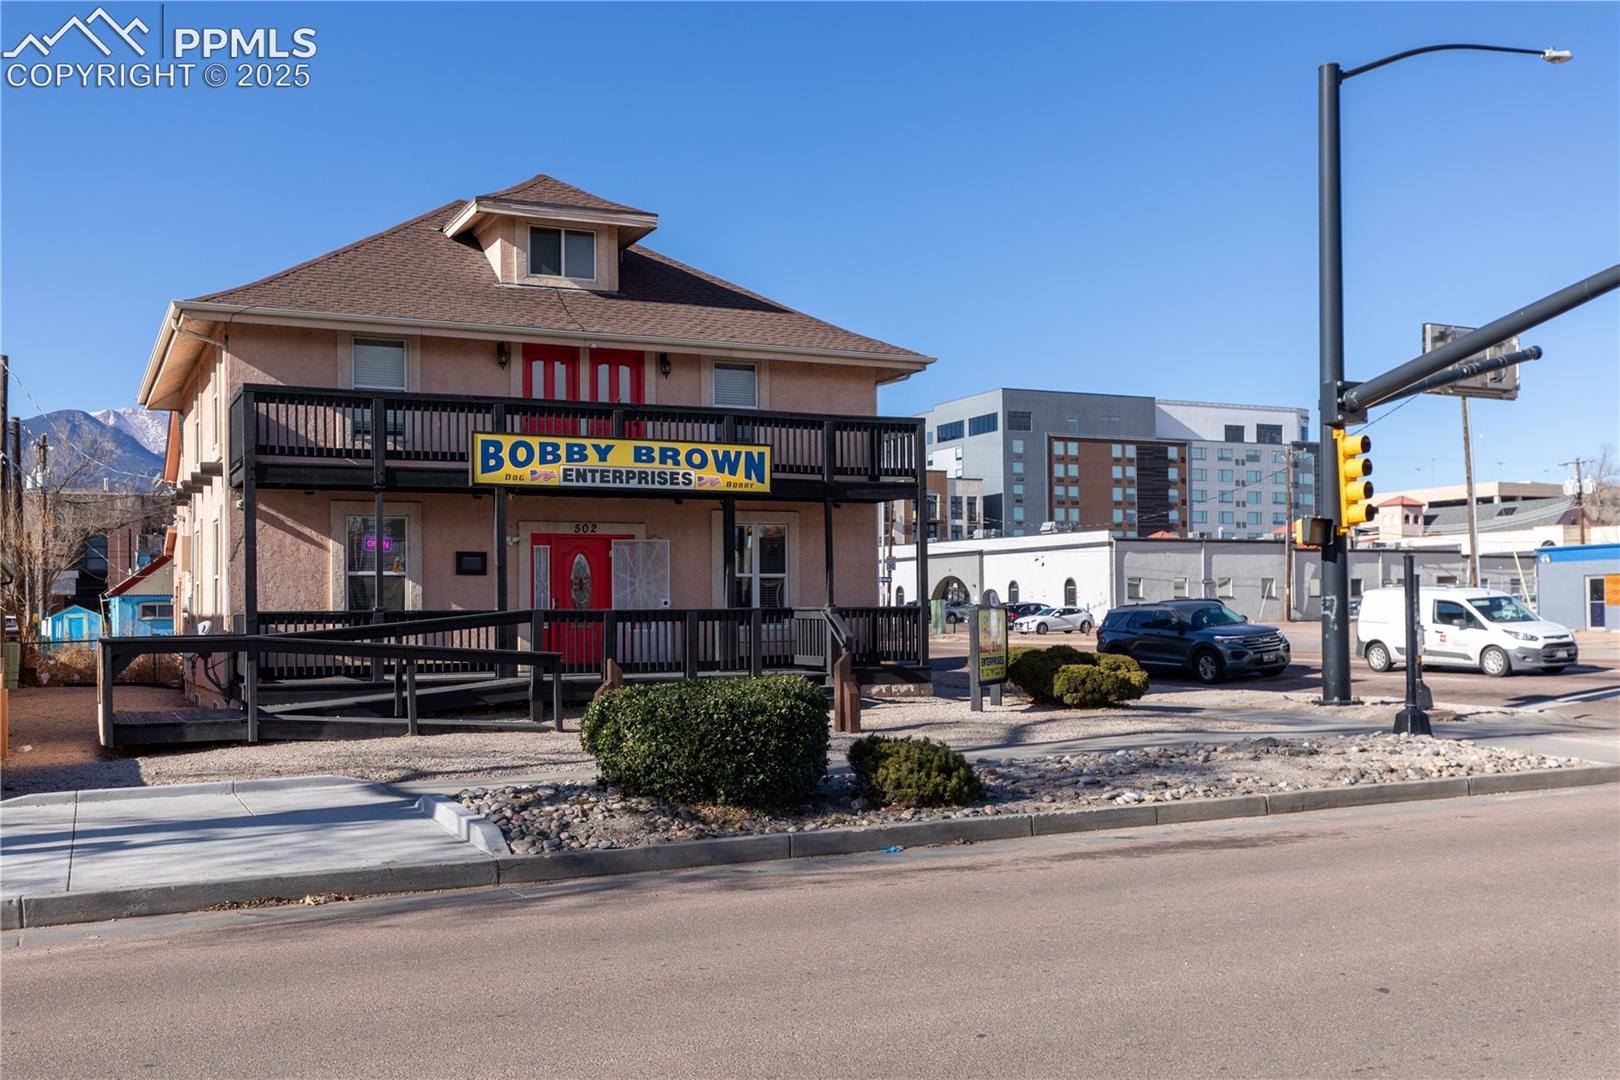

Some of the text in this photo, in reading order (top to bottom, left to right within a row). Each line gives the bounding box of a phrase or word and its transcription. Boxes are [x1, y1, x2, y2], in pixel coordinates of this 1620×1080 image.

[480, 438, 765, 485] BOBBY BROWN
[562, 467, 693, 486] ENTERPRISES
[574, 523, 597, 533] 502
